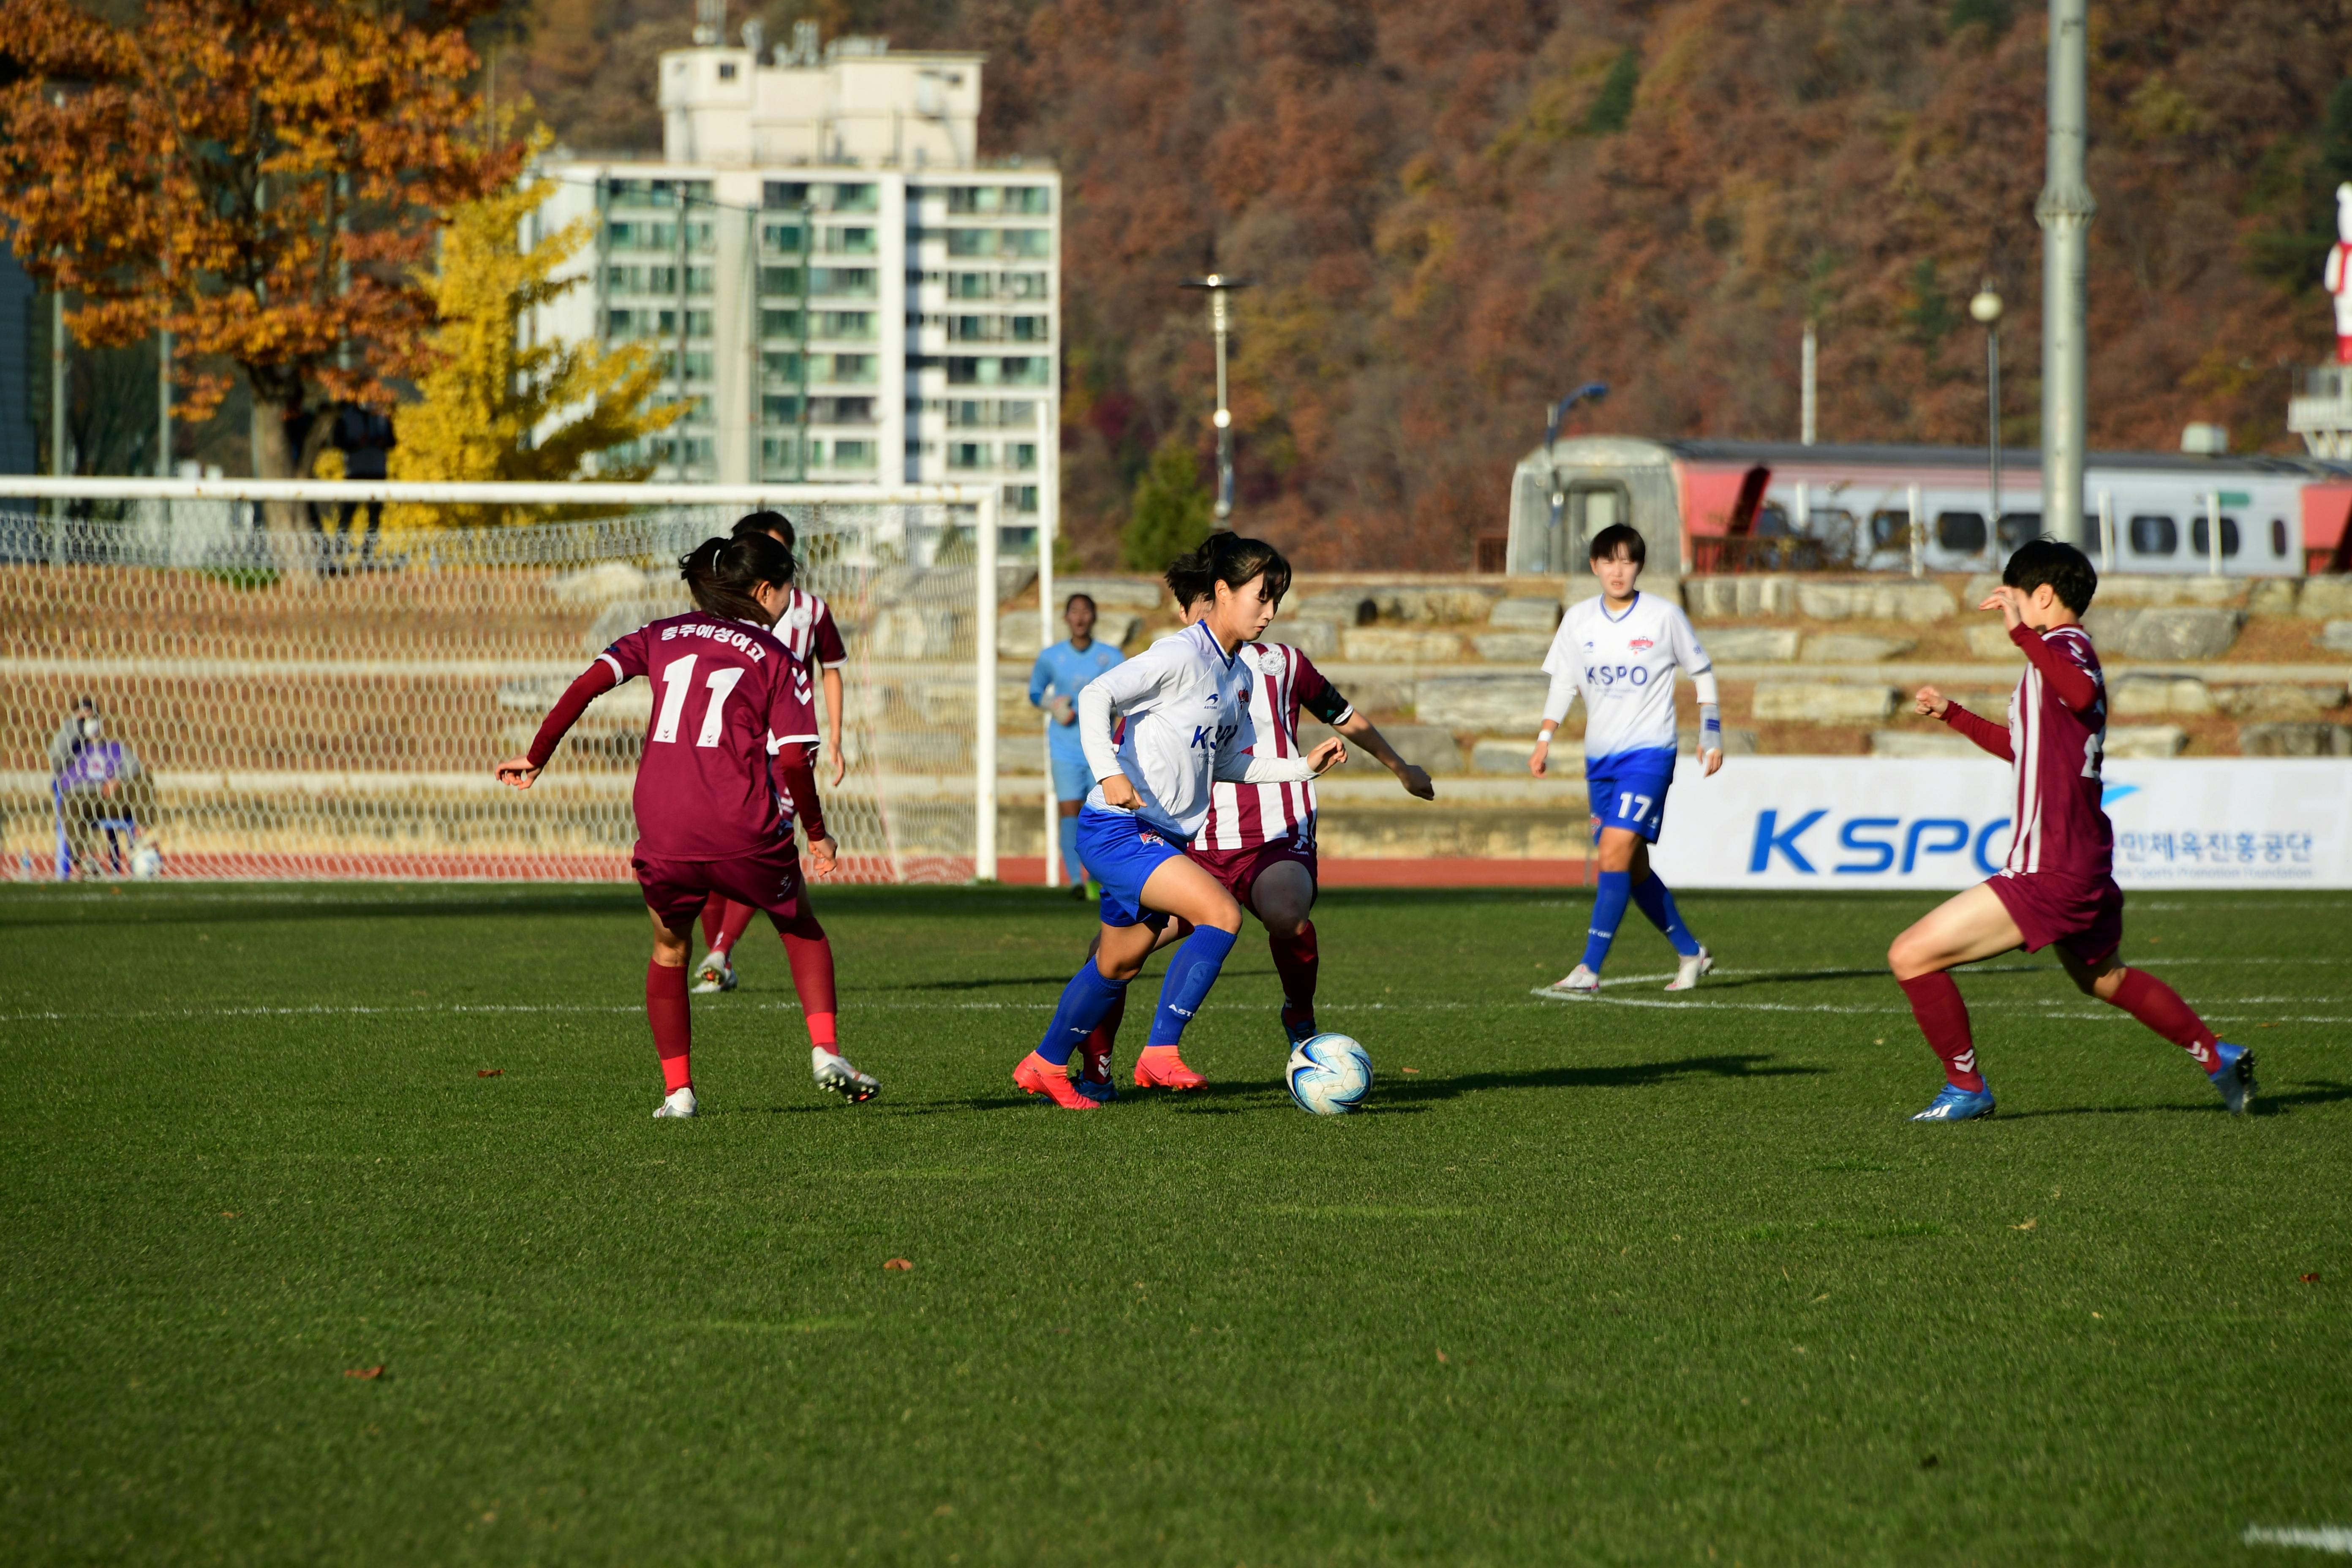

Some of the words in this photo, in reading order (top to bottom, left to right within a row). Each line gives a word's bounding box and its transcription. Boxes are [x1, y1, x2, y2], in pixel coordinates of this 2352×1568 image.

[1584, 666, 1648, 686] KSPO
[653, 653, 745, 748] 11
[1617, 792, 1652, 822] 17
[2113, 831, 2313, 862] 민체육진흥공단
